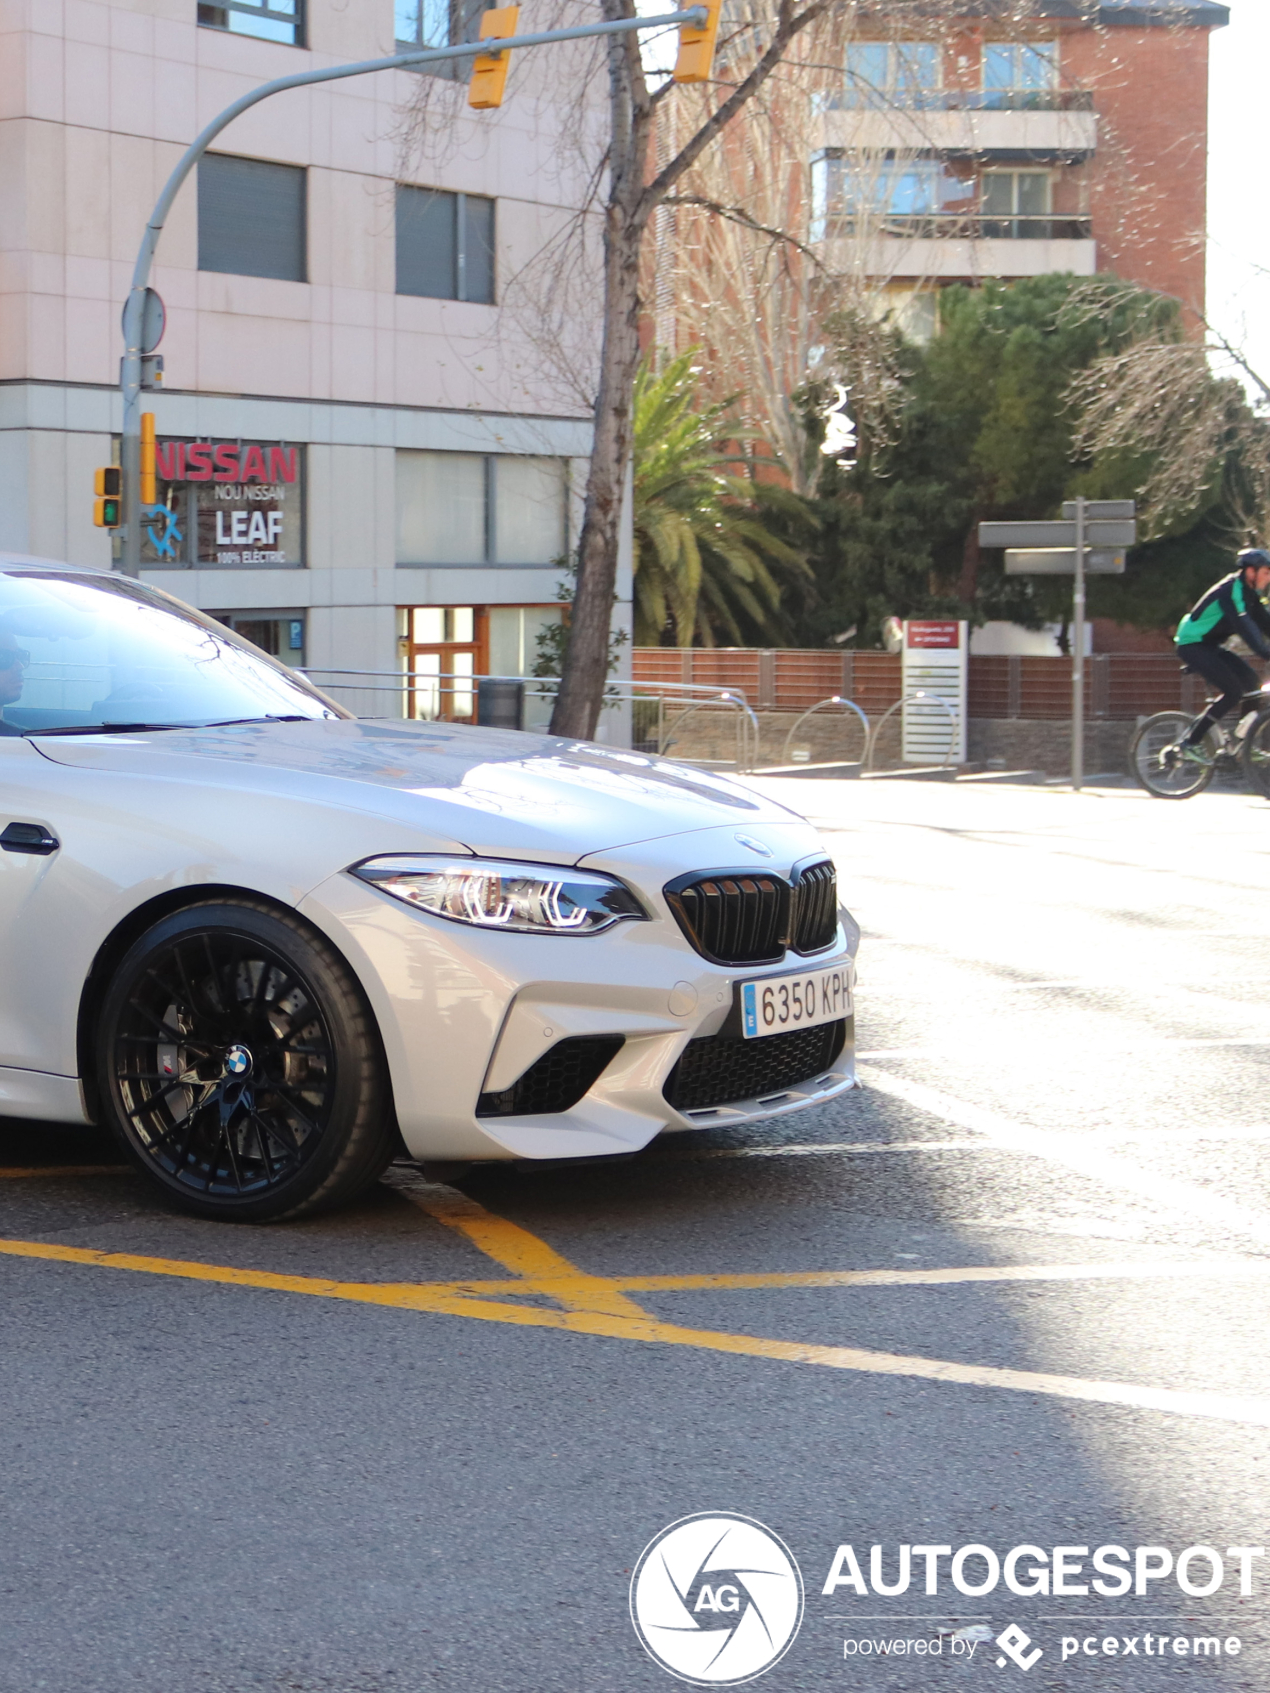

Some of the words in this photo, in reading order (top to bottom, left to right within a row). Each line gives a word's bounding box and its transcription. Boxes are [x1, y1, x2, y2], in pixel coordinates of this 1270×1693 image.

[155, 442, 296, 483] NISSAN
[215, 485, 241, 500] NOU
[245, 486, 286, 501] NISSAN
[215, 511, 284, 545] LEAF
[217, 552, 240, 563] 100%
[762, 980, 816, 1026] 6350
[821, 970, 851, 1015] KPH
